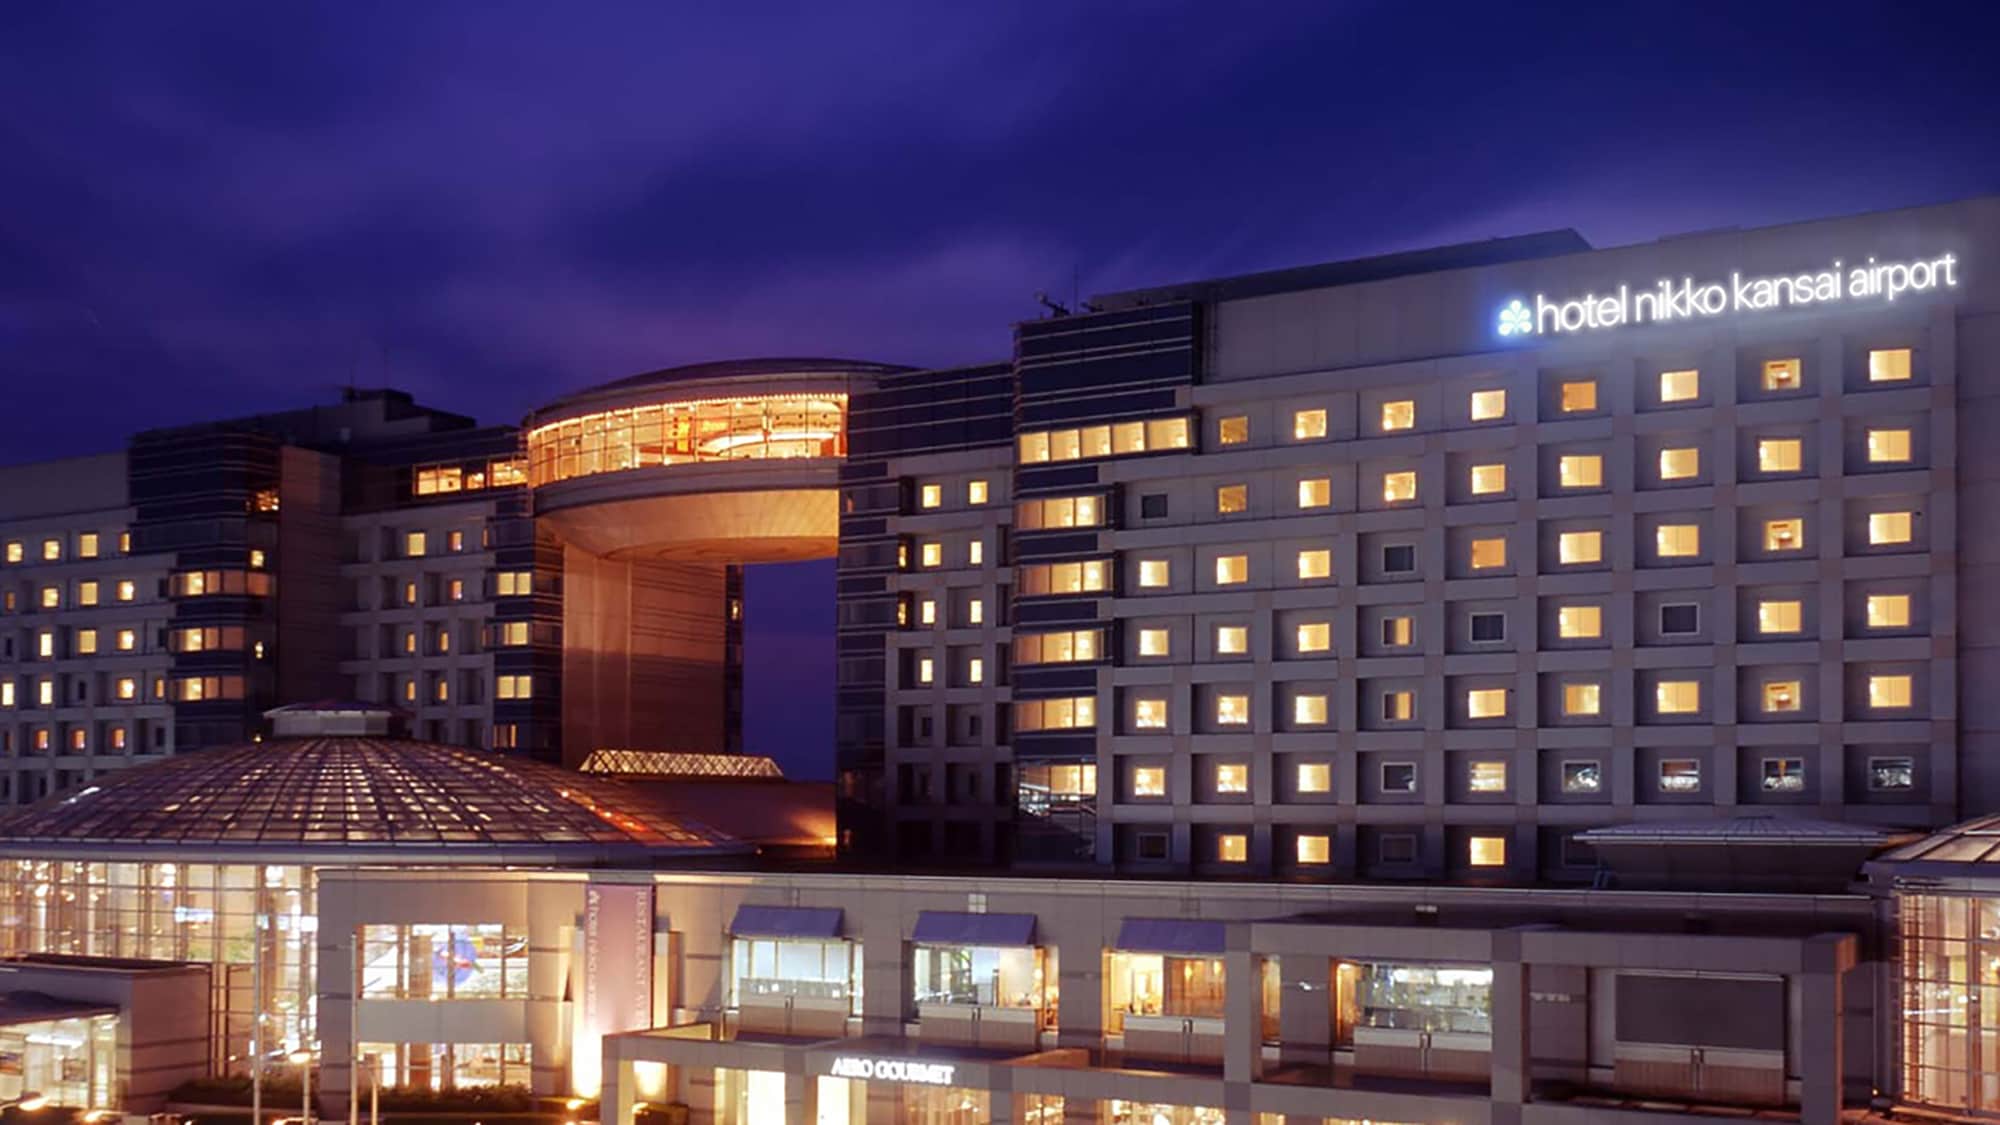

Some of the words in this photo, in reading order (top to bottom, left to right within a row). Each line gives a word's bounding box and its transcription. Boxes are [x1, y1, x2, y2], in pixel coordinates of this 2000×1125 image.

[1536, 286, 1628, 333] hotel
[1636, 280, 1726, 320] nikko
[1733, 262, 1841, 310] kansai
[1849, 253, 1956, 299] airport
[875, 1060, 954, 1085] GOURMET
